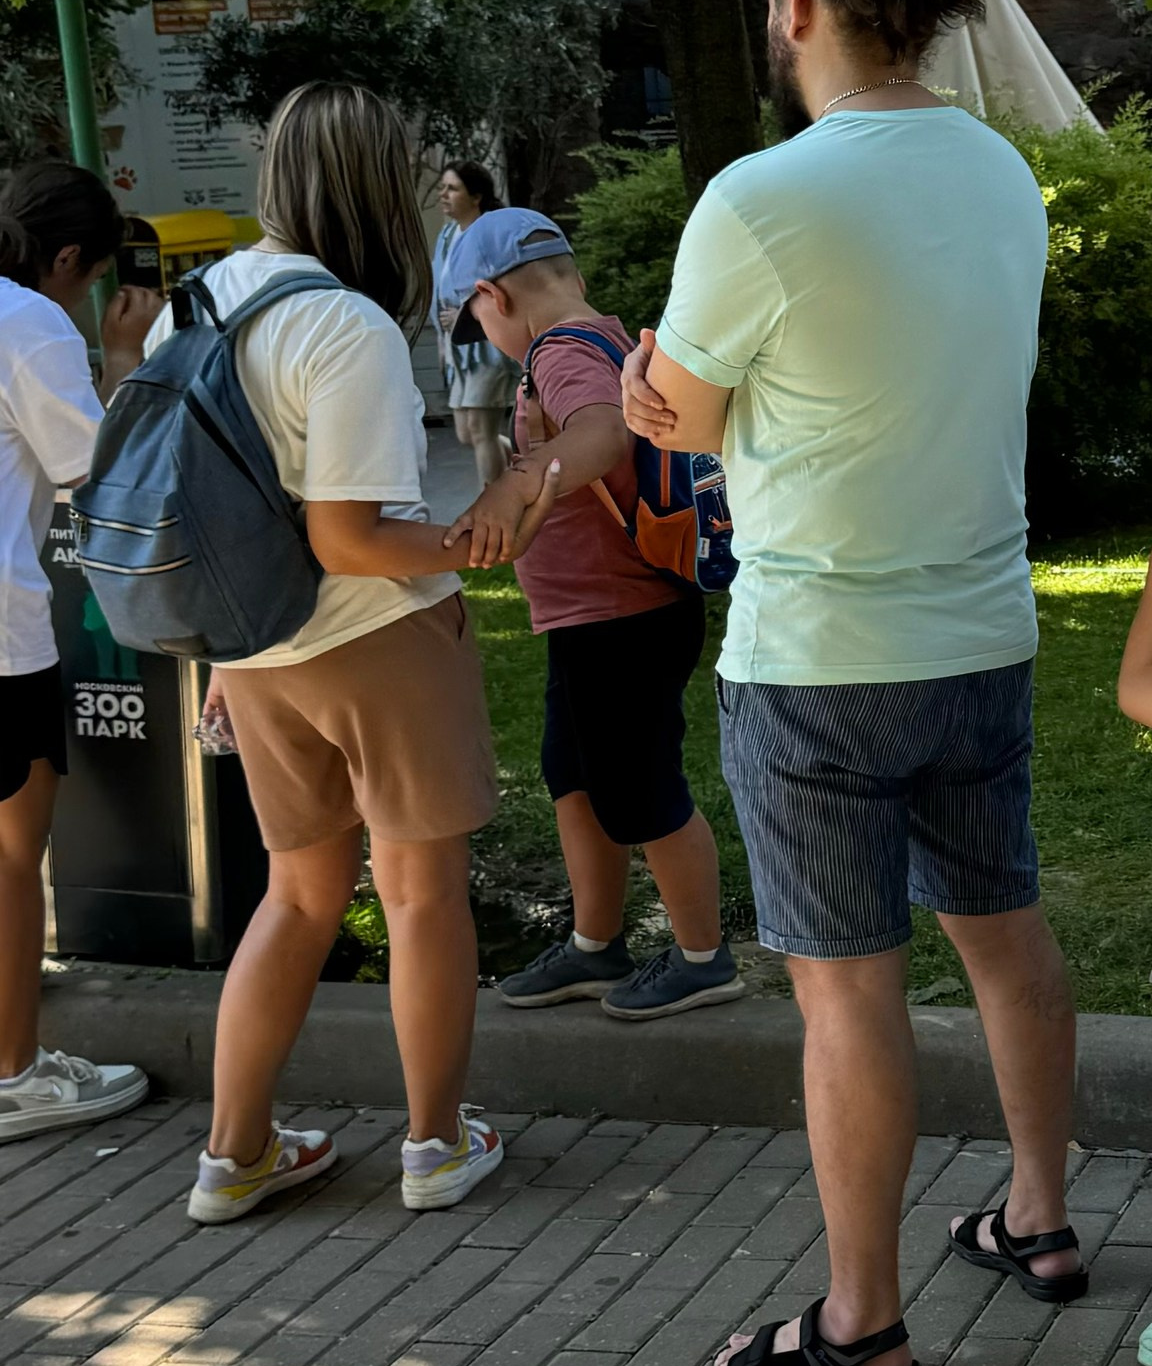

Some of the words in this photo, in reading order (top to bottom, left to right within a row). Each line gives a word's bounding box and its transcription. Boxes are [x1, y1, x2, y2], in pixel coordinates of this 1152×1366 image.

[75, 682, 143, 693] МОСКОВСКИЙ
[75, 691, 144, 719] ЗОО
[77, 717, 147, 740] ПАРК
